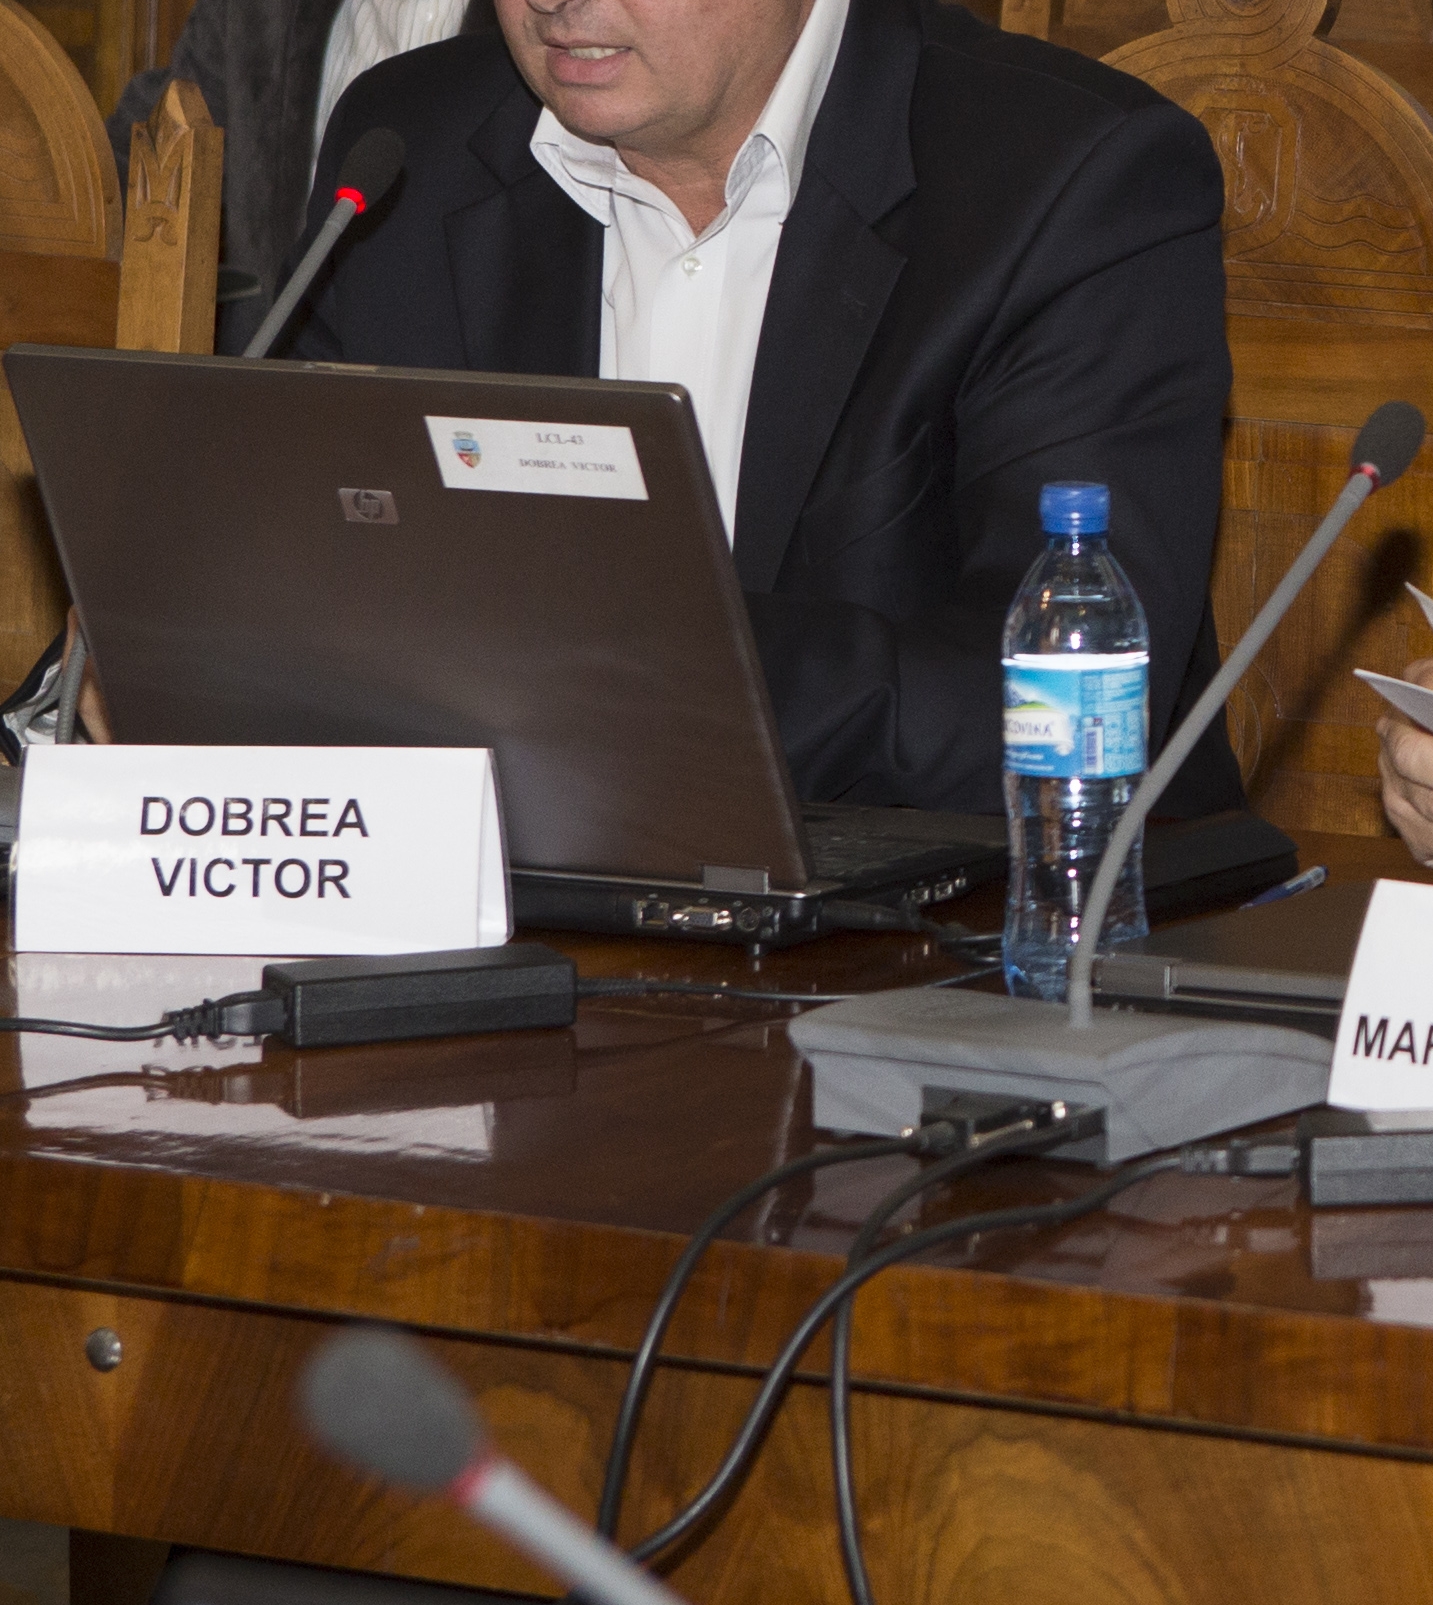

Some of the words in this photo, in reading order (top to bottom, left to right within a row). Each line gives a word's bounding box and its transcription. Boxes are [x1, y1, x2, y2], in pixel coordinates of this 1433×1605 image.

[519, 458, 567, 470] DOBREA
[571, 461, 617, 473] VICTOR
[140, 796, 369, 837] DOBREA
[151, 857, 351, 898] VICTOR
